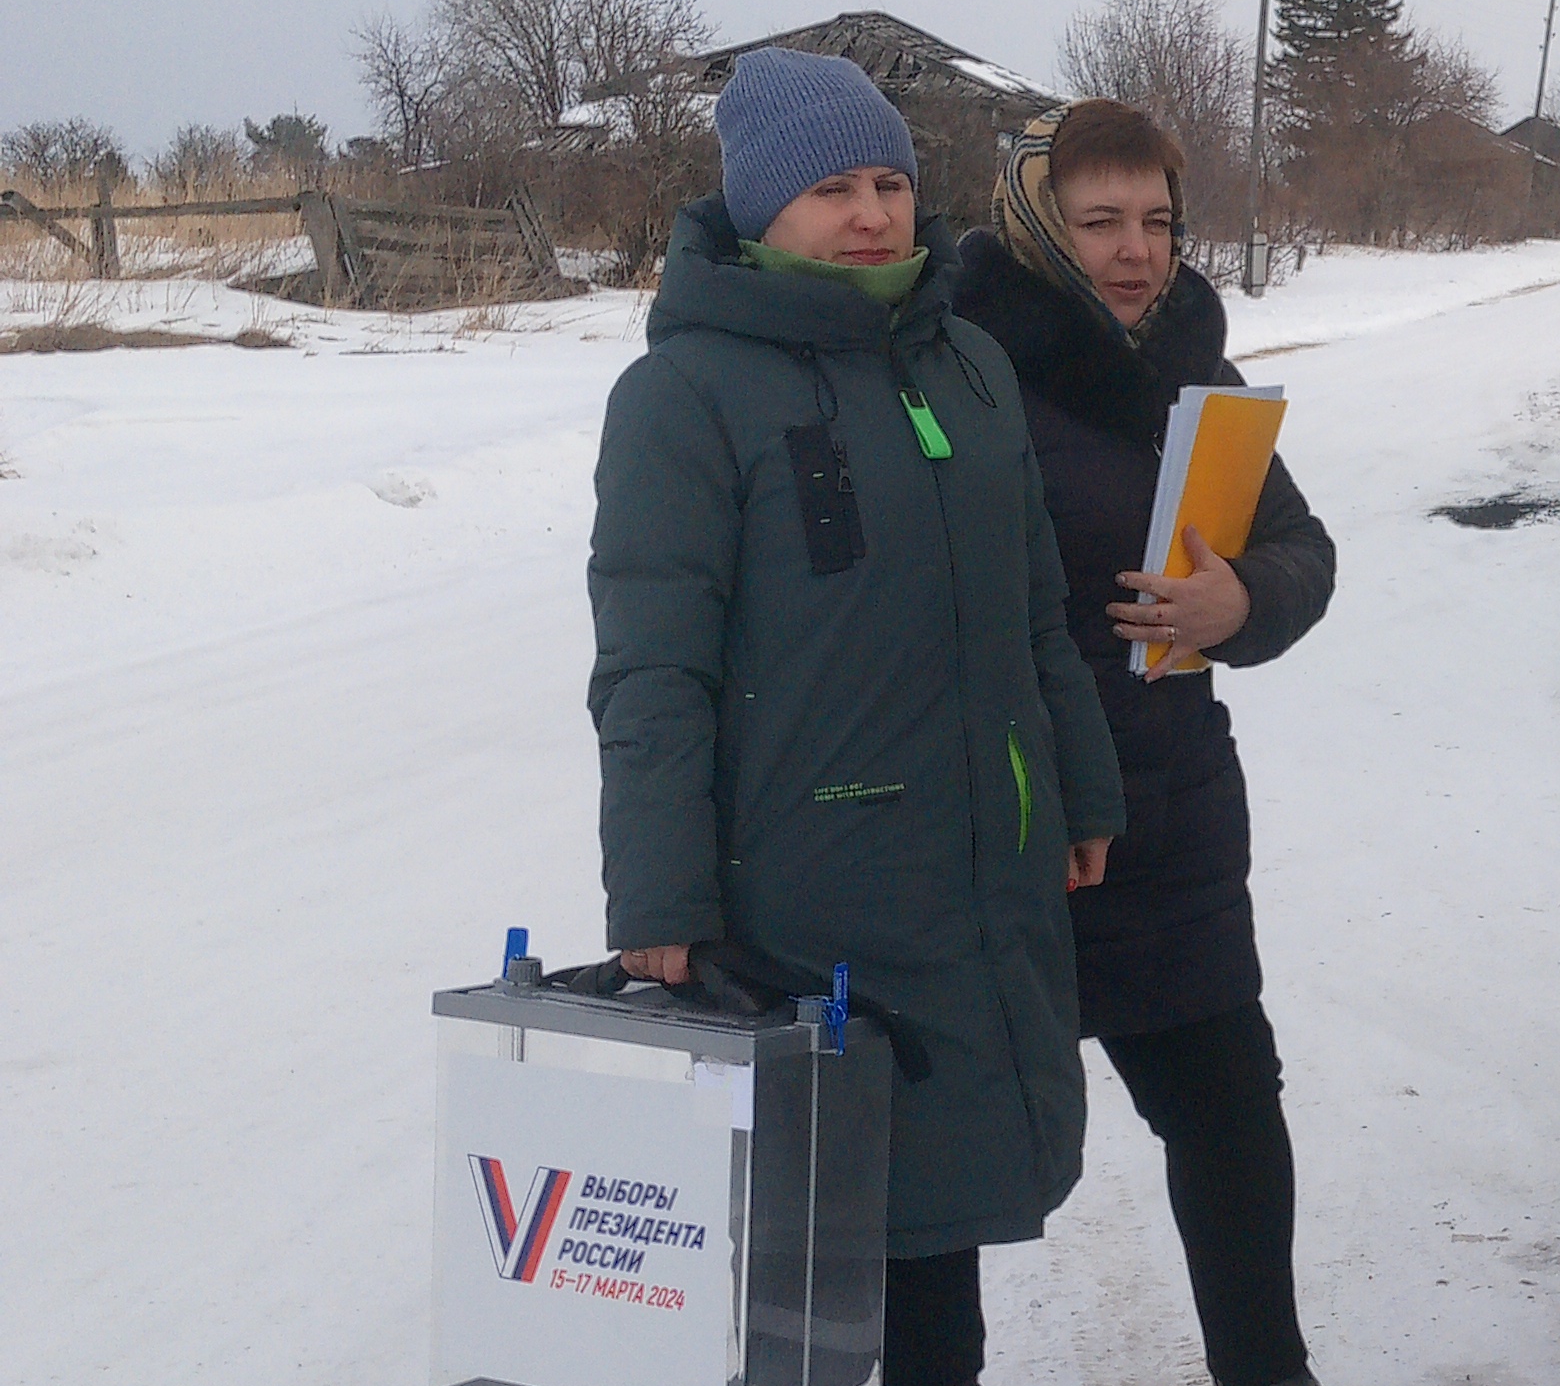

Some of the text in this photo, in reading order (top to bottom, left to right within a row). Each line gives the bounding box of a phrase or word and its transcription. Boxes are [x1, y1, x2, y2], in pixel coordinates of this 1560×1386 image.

[580, 1174, 679, 1211] ВЫБОРЫ
[568, 1206, 706, 1250] ПРЕЗИДЕНТА
[557, 1237, 646, 1274] РОССИИ
[592, 1275, 646, 1304] МАРТА
[646, 1285, 685, 1311] 2024
